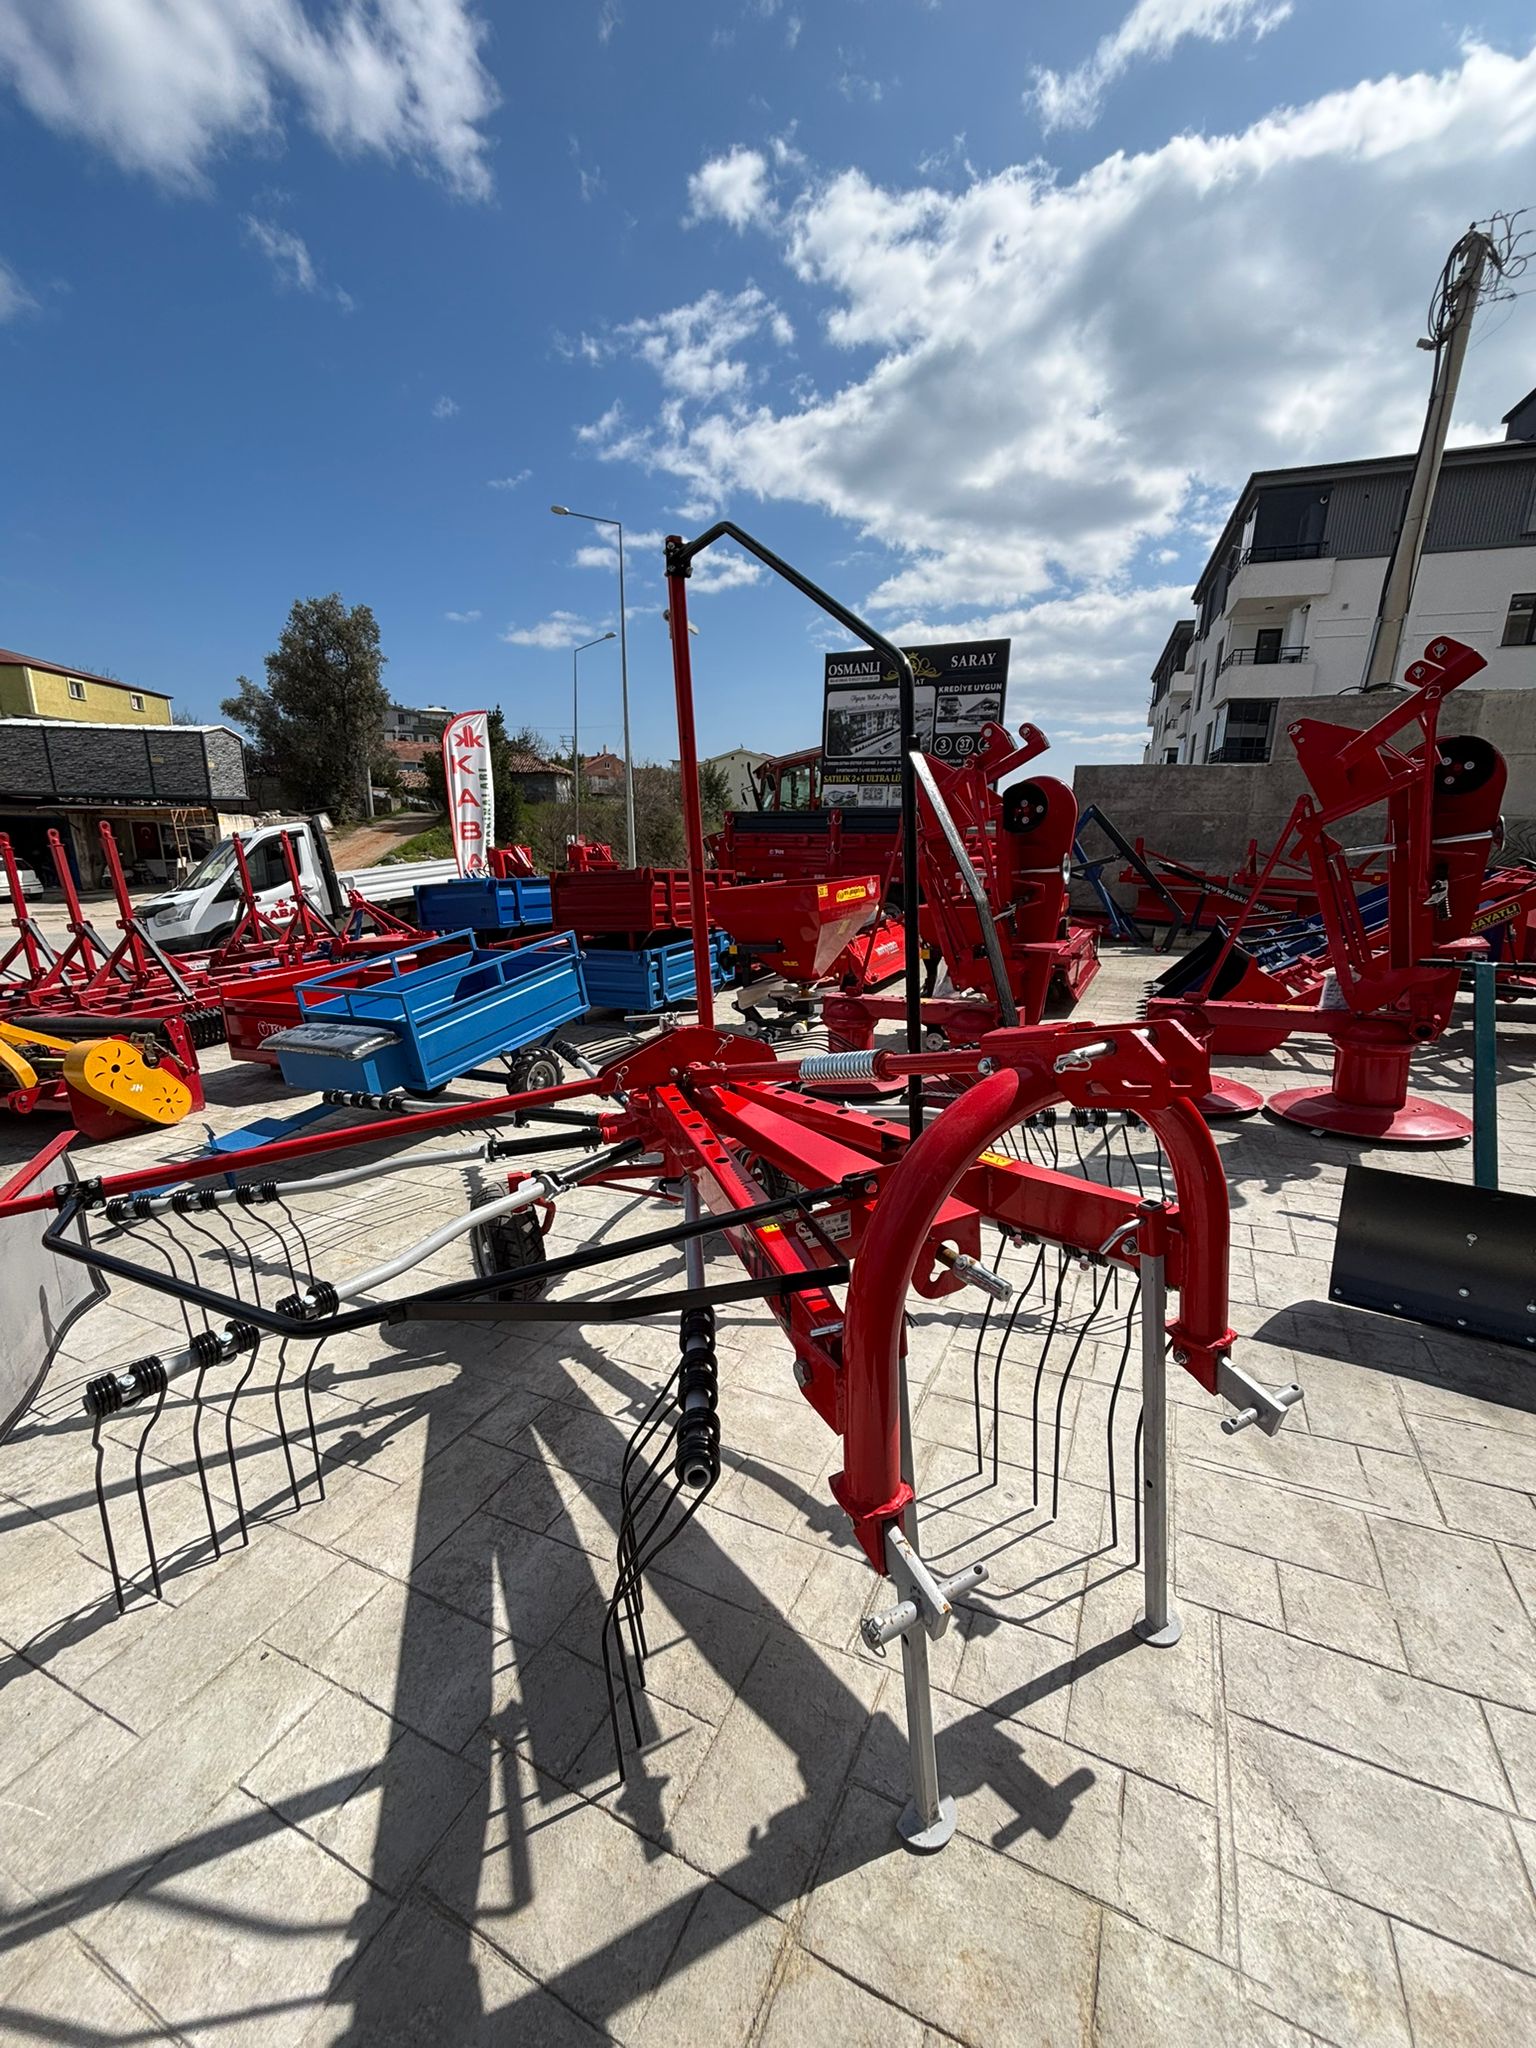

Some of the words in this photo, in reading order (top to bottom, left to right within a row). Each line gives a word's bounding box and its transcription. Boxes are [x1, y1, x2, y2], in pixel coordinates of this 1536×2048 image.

[951, 652, 997, 668] SARAY
[828, 661, 881, 676] OSMANLI
[974, 682, 1002, 692] UYGUN
[959, 738, 971, 748] 37
